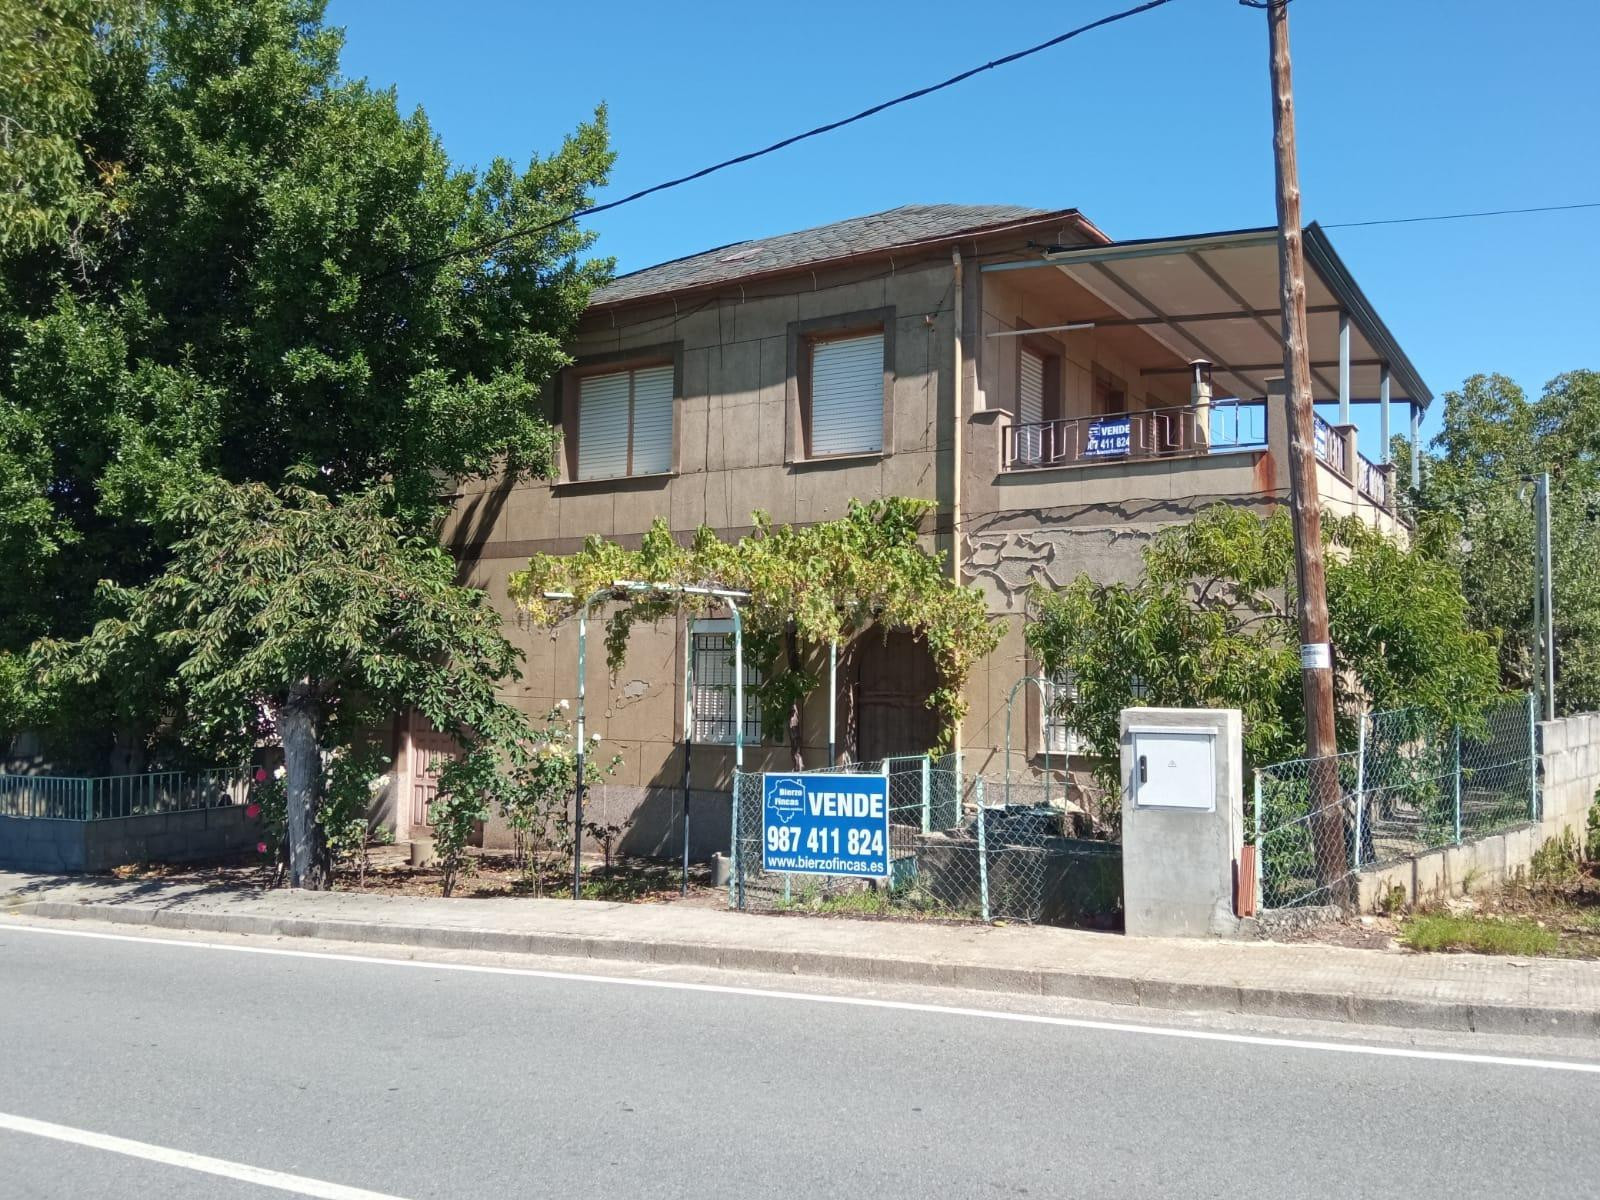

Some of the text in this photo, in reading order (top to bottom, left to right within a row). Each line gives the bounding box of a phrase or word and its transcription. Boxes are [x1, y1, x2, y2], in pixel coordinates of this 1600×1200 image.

[1101, 424, 1130, 435] VENDE
[1100, 438, 1114, 449] 411
[779, 788, 802, 796] Bierzo
[774, 797, 799, 806] Fincas
[808, 792, 883, 818] VENDE
[767, 825, 884, 856] 987 411 824
[767, 855, 884, 873] www.bierzofincas.es
